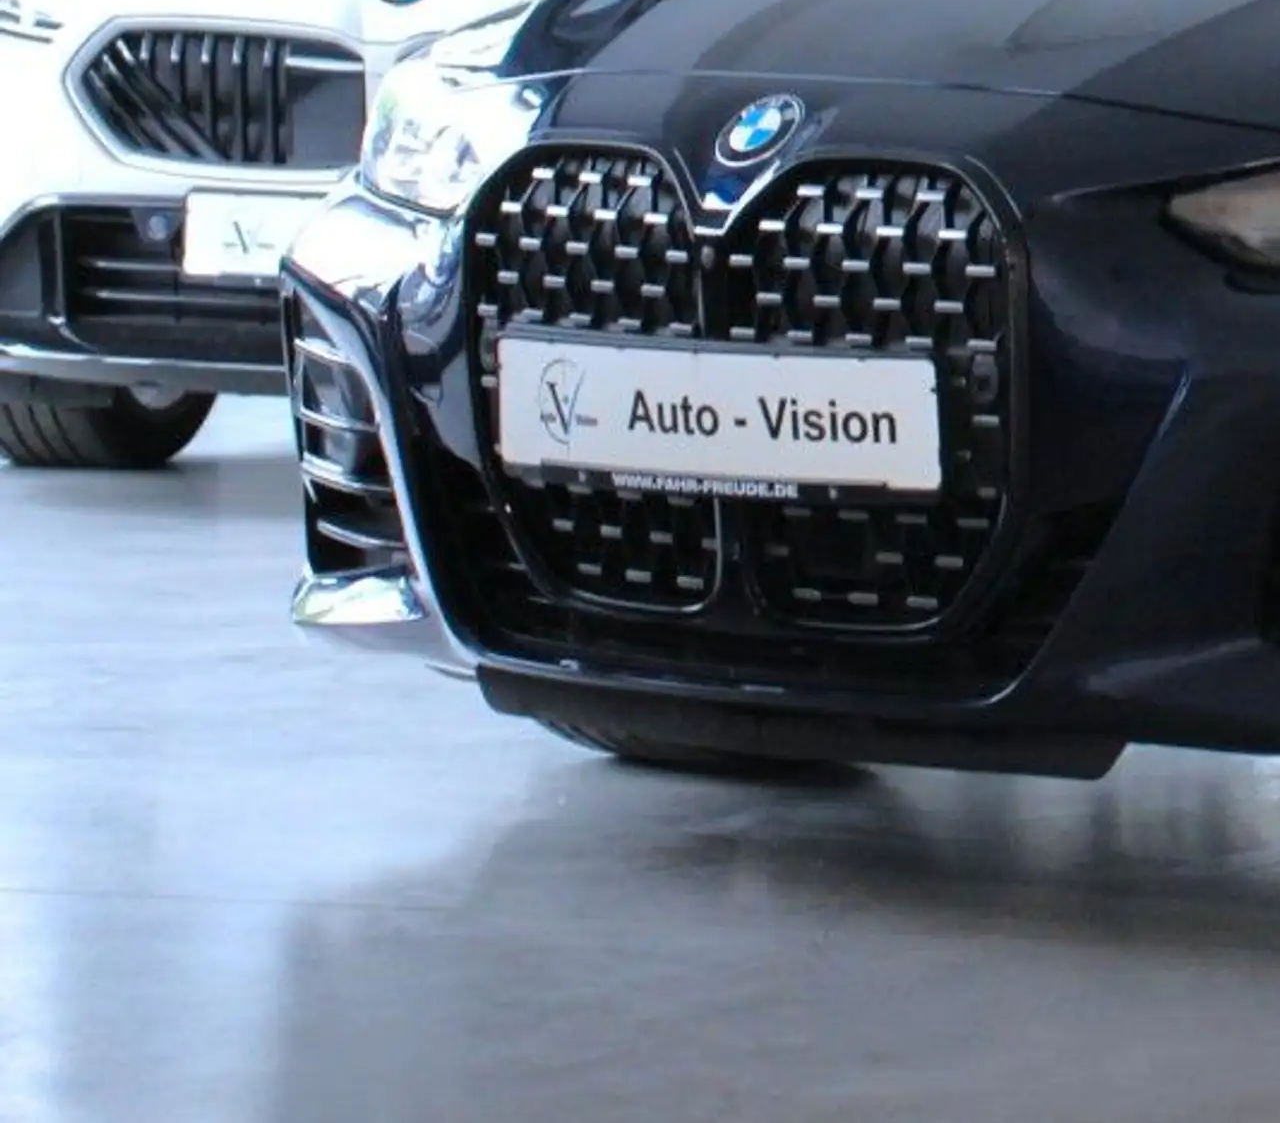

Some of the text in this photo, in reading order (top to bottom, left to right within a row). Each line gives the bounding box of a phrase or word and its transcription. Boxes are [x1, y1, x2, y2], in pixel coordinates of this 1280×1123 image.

[627, 389, 719, 437] Auto
[758, 395, 897, 444] Vision
[611, 471, 798, 500] WWW.FAHR-FREUDE.DE
